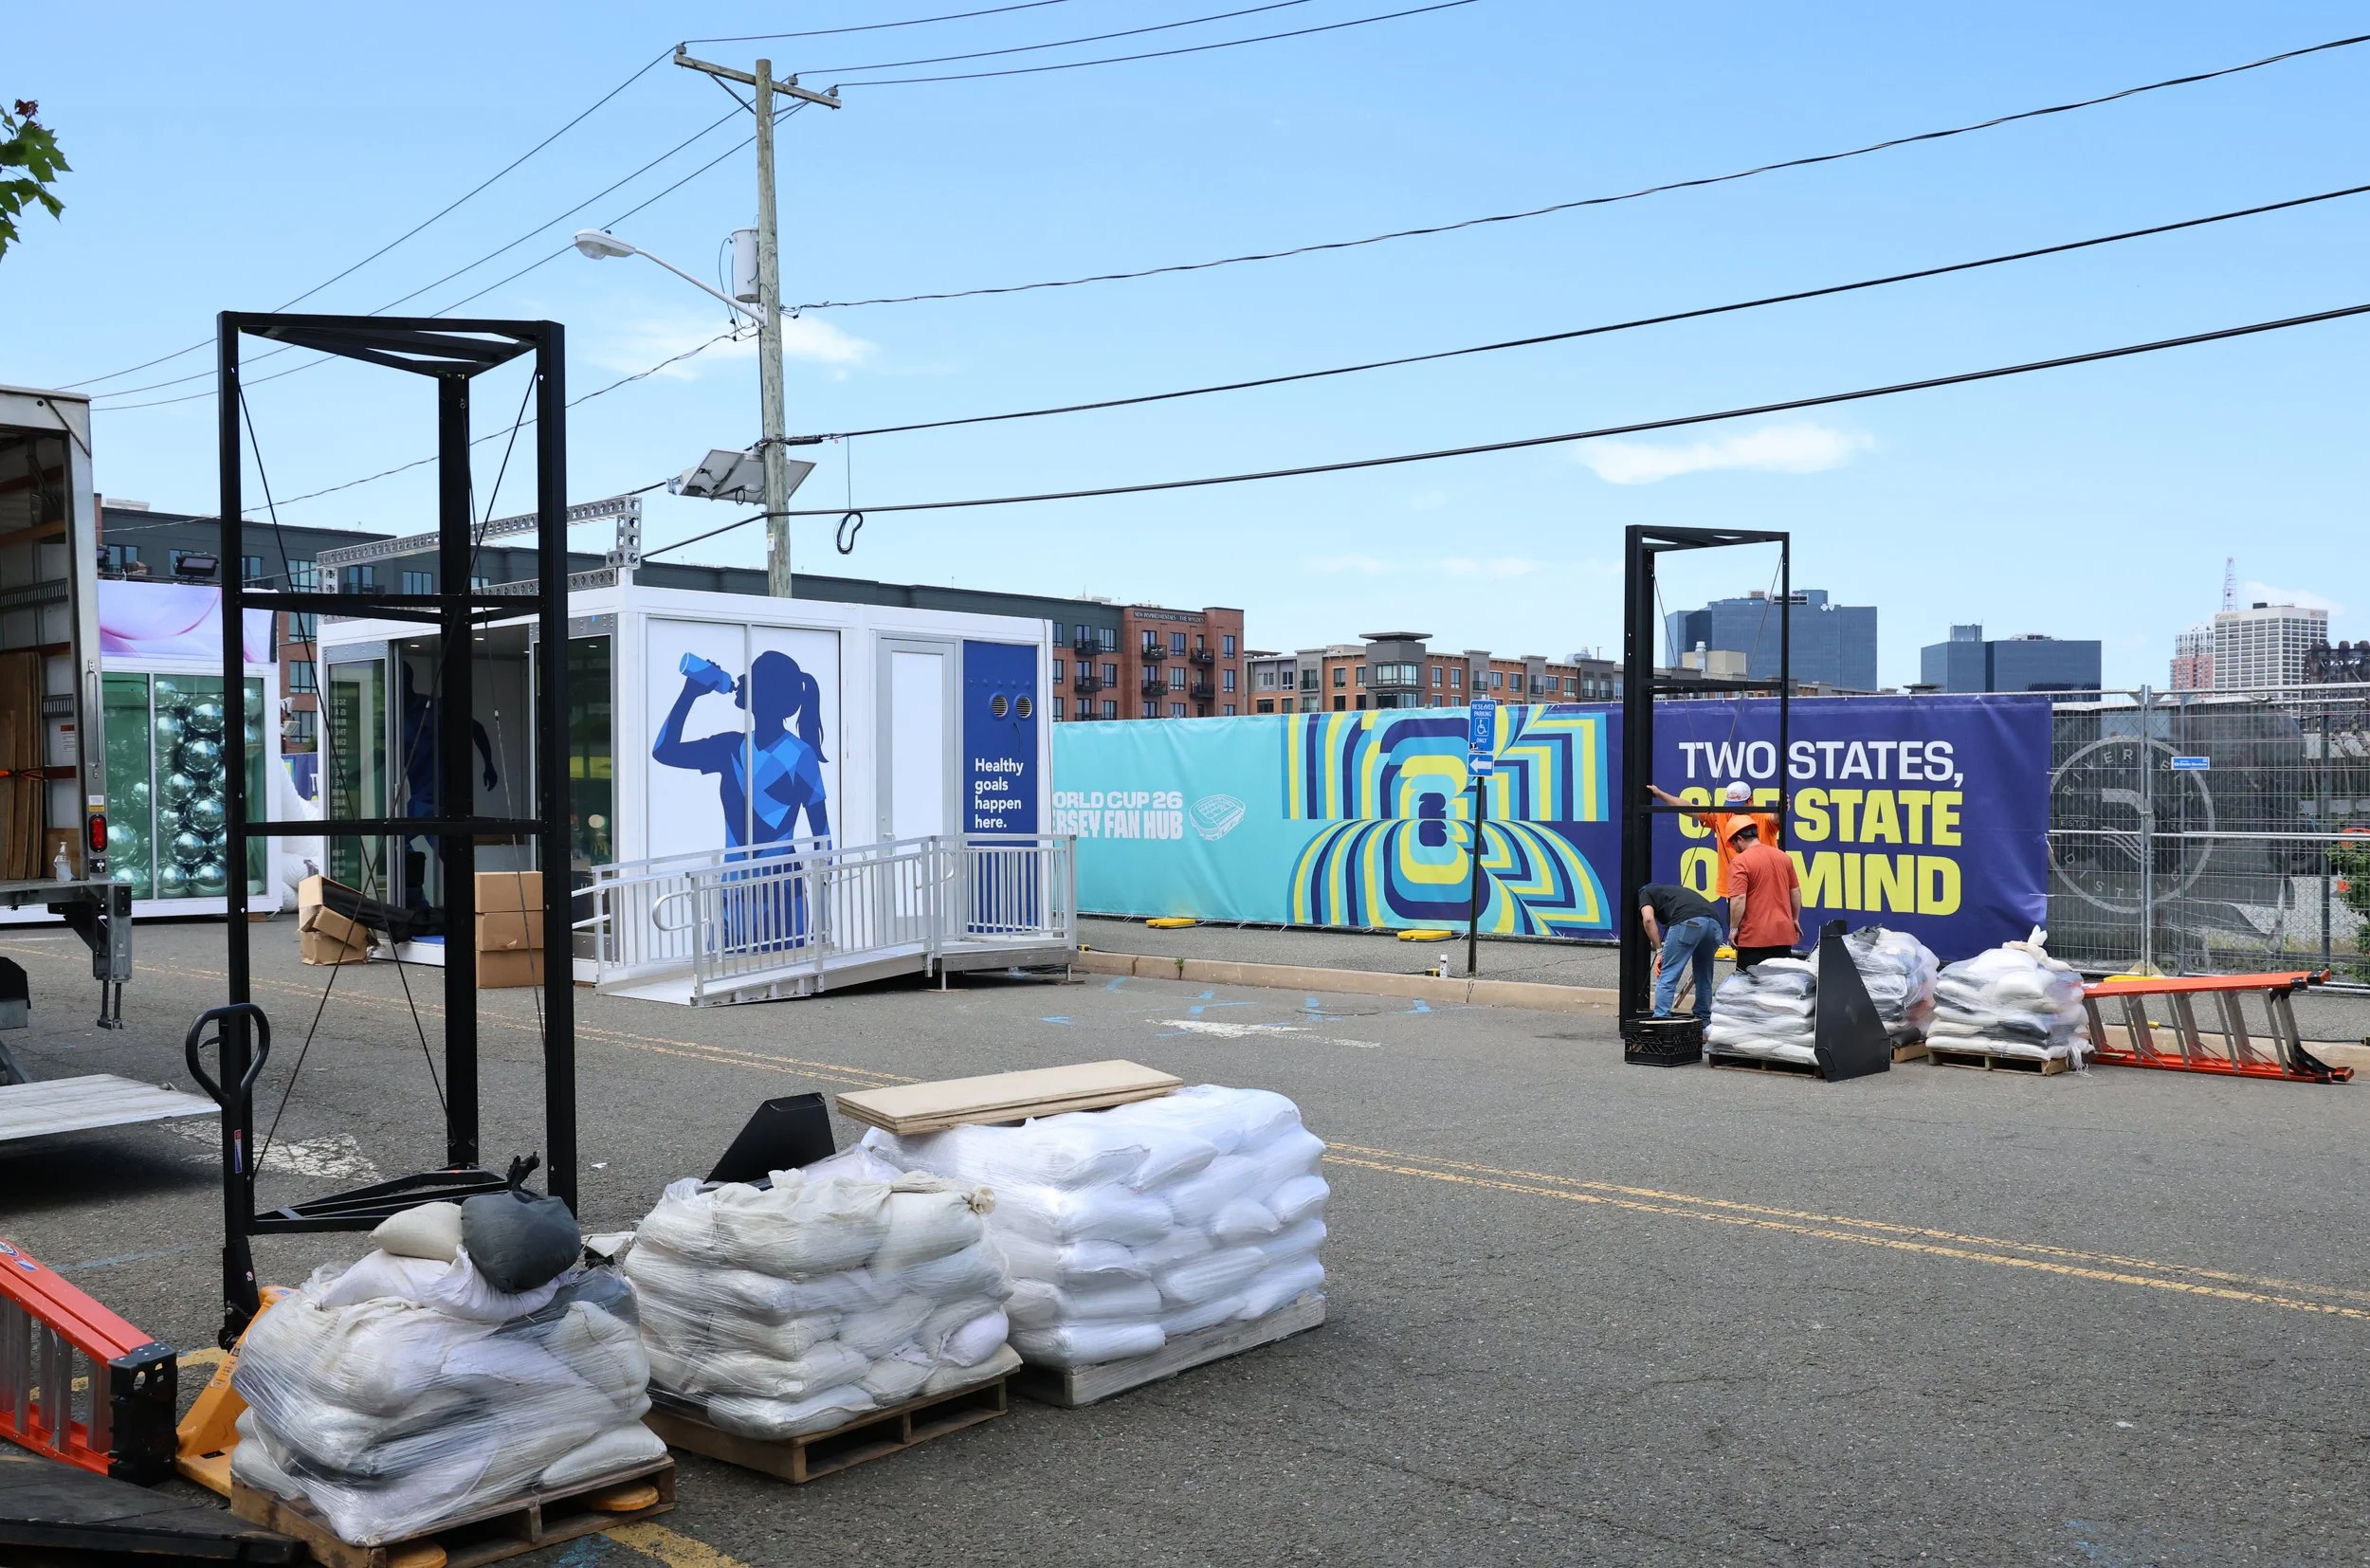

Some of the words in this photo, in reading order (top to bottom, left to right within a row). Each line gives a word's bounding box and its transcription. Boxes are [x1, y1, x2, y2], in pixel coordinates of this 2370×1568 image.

[975, 757, 1024, 776] Healthy
[1679, 740, 1777, 780] TWO
[1788, 740, 1963, 788] STATES,
[975, 775, 1009, 794] goals
[975, 794, 1022, 813] happen
[1053, 791, 1104, 809] ORLD
[1106, 791, 1150, 809] CUP
[1152, 791, 1183, 810] 26
[975, 813, 1008, 829] here.
[1052, 809, 1102, 838] RSEY
[1103, 810, 1140, 839] FAN
[1143, 810, 1183, 840] HUB
[1794, 787, 1963, 847] STATE
[1785, 850, 1961, 916] MIND
